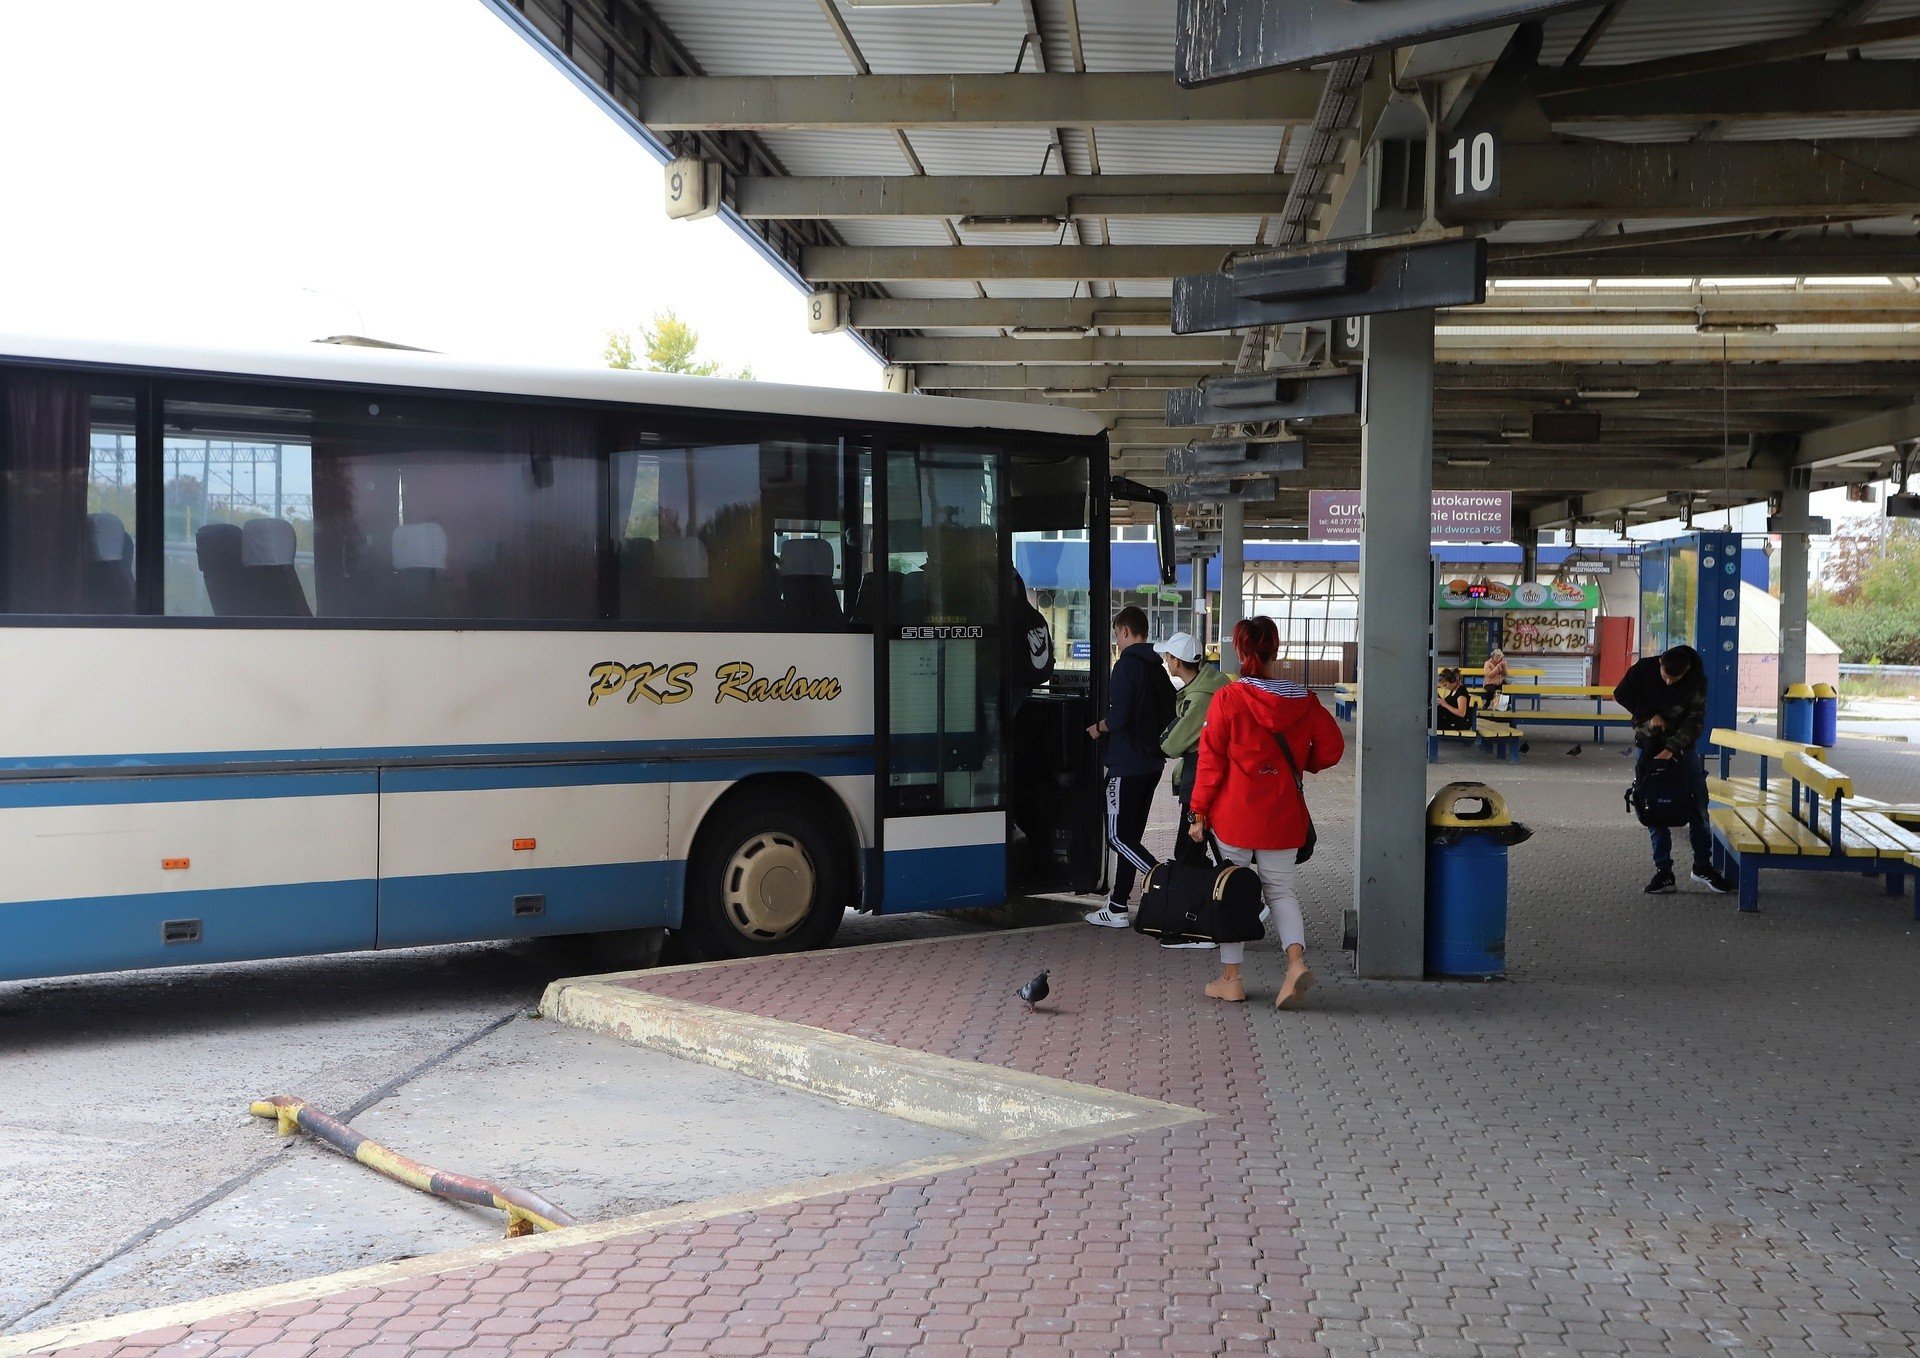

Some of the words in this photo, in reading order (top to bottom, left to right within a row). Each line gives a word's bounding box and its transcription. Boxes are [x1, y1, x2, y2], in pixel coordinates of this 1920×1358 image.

[1448, 131, 1494, 195] 10
[670, 172, 684, 201] 9
[812, 300, 822, 321] 8
[1346, 316, 1360, 348] 9
[886, 373, 895, 390] 7
[1892, 462, 1902, 483] 16
[1452, 510, 1502, 521] lotnicze
[1680, 506, 1688, 521] 18
[1445, 525, 1480, 533] dworca
[1483, 525, 1502, 534] PKS
[1614, 519, 1623, 532] 19
[901, 625, 983, 639] SETRA
[588, 661, 698, 707] PKS
[714, 661, 842, 704] Radom
